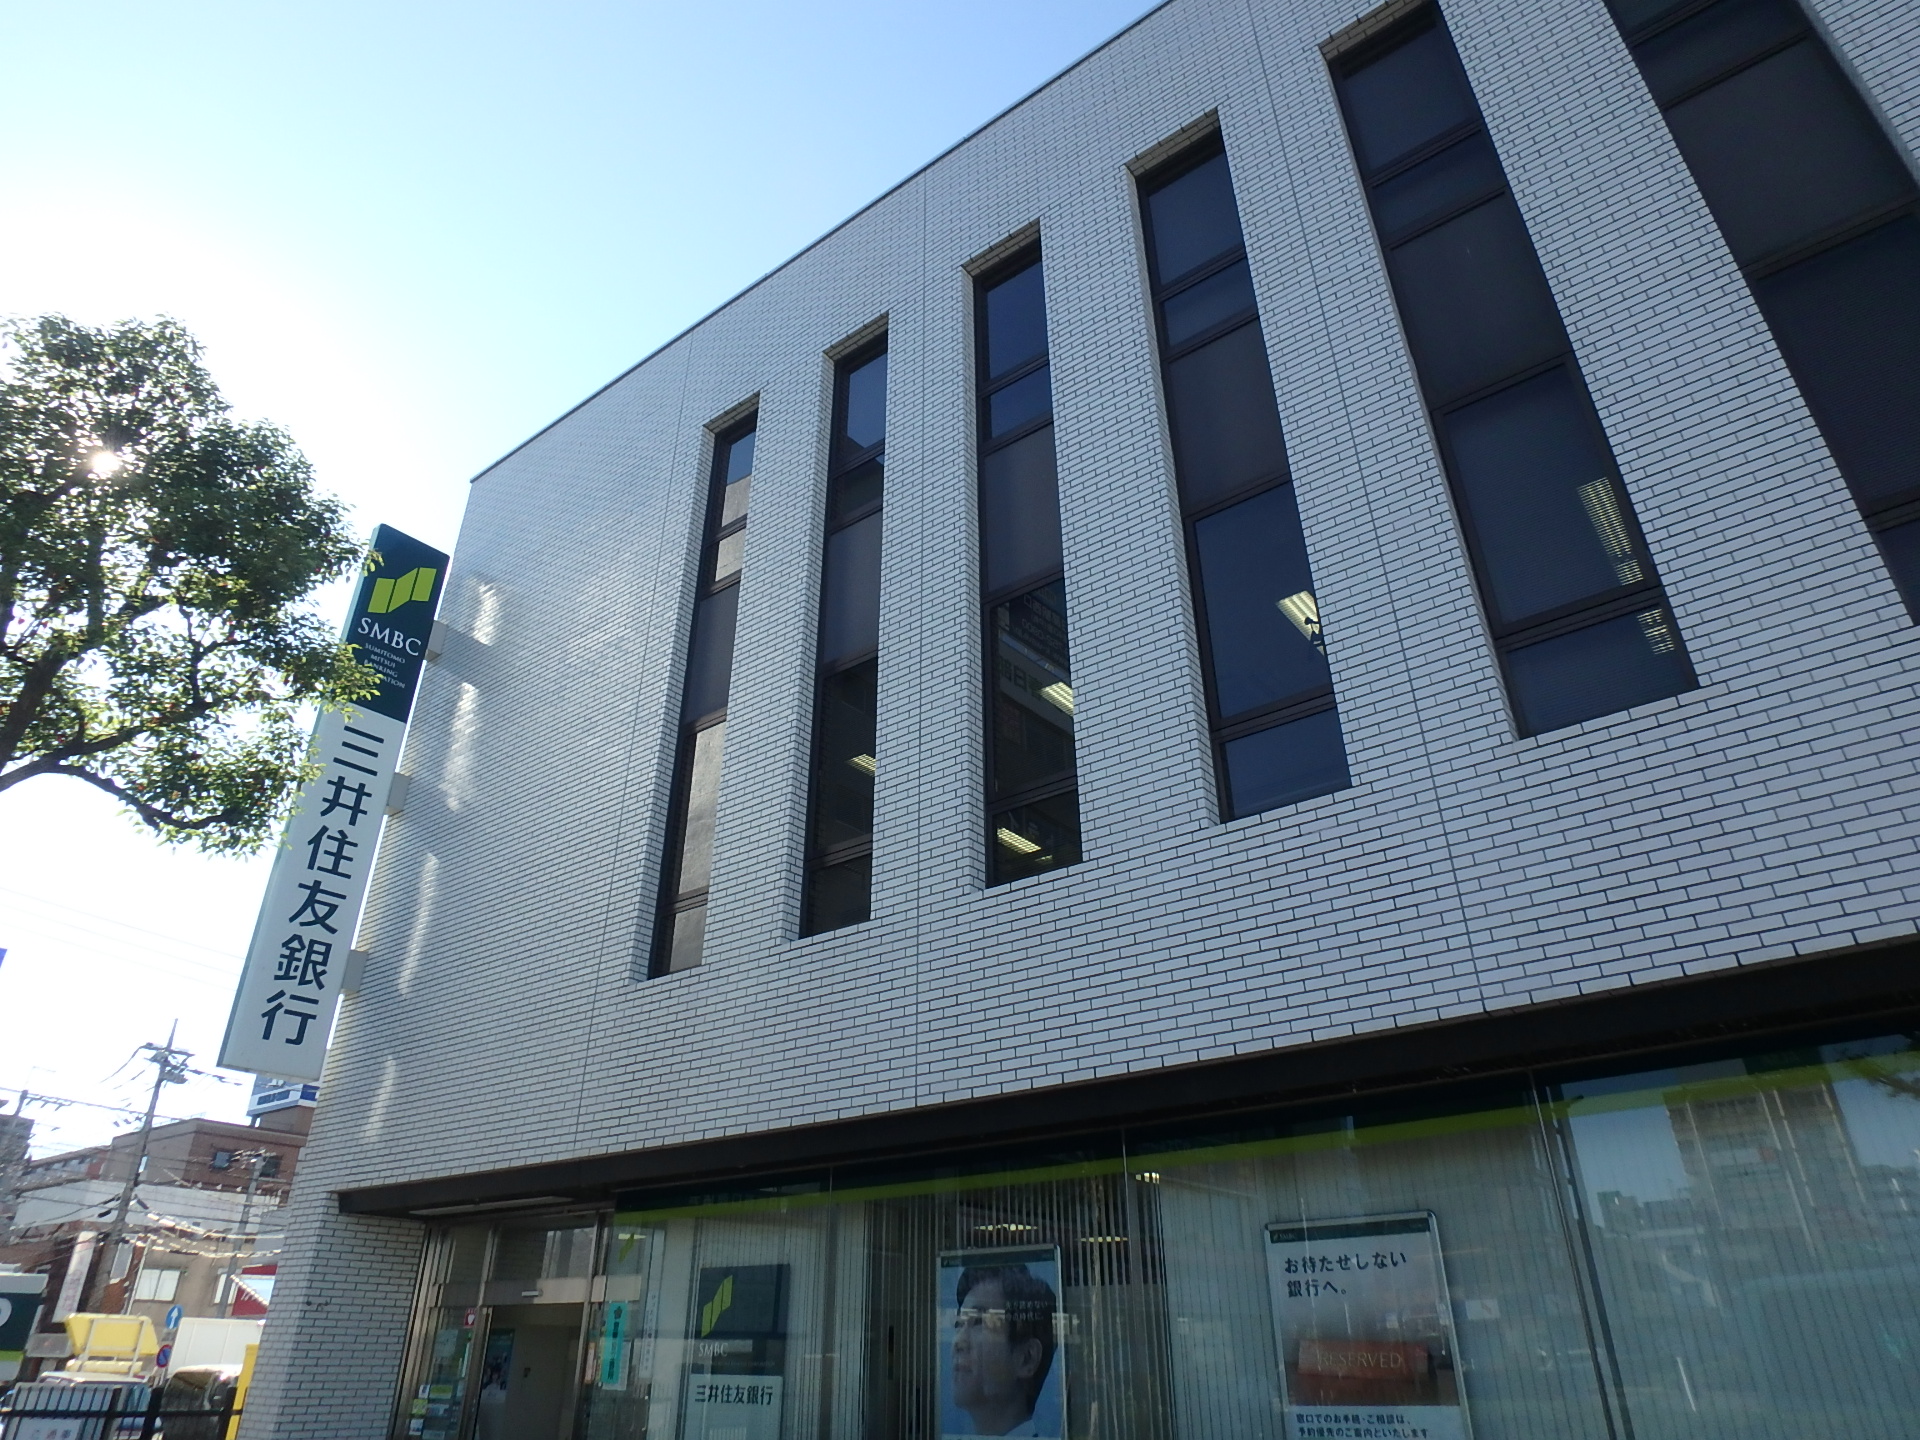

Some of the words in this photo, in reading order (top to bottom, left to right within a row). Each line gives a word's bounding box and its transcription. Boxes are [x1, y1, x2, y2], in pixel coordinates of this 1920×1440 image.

[357, 617, 422, 657] SMBC
[364, 642, 406, 664] SUMITOMO
[370, 653, 396, 669] MITSUI
[262, 725, 385, 1047] 三井住友銀行
[1284, 1251, 1408, 1275] お待たせしない
[1287, 1279, 1348, 1299] 銀行へ。
[698, 1342, 730, 1357] SMBC
[1319, 1350, 1404, 1369] RESERVED
[694, 1384, 774, 1406] 三井住友銀行
